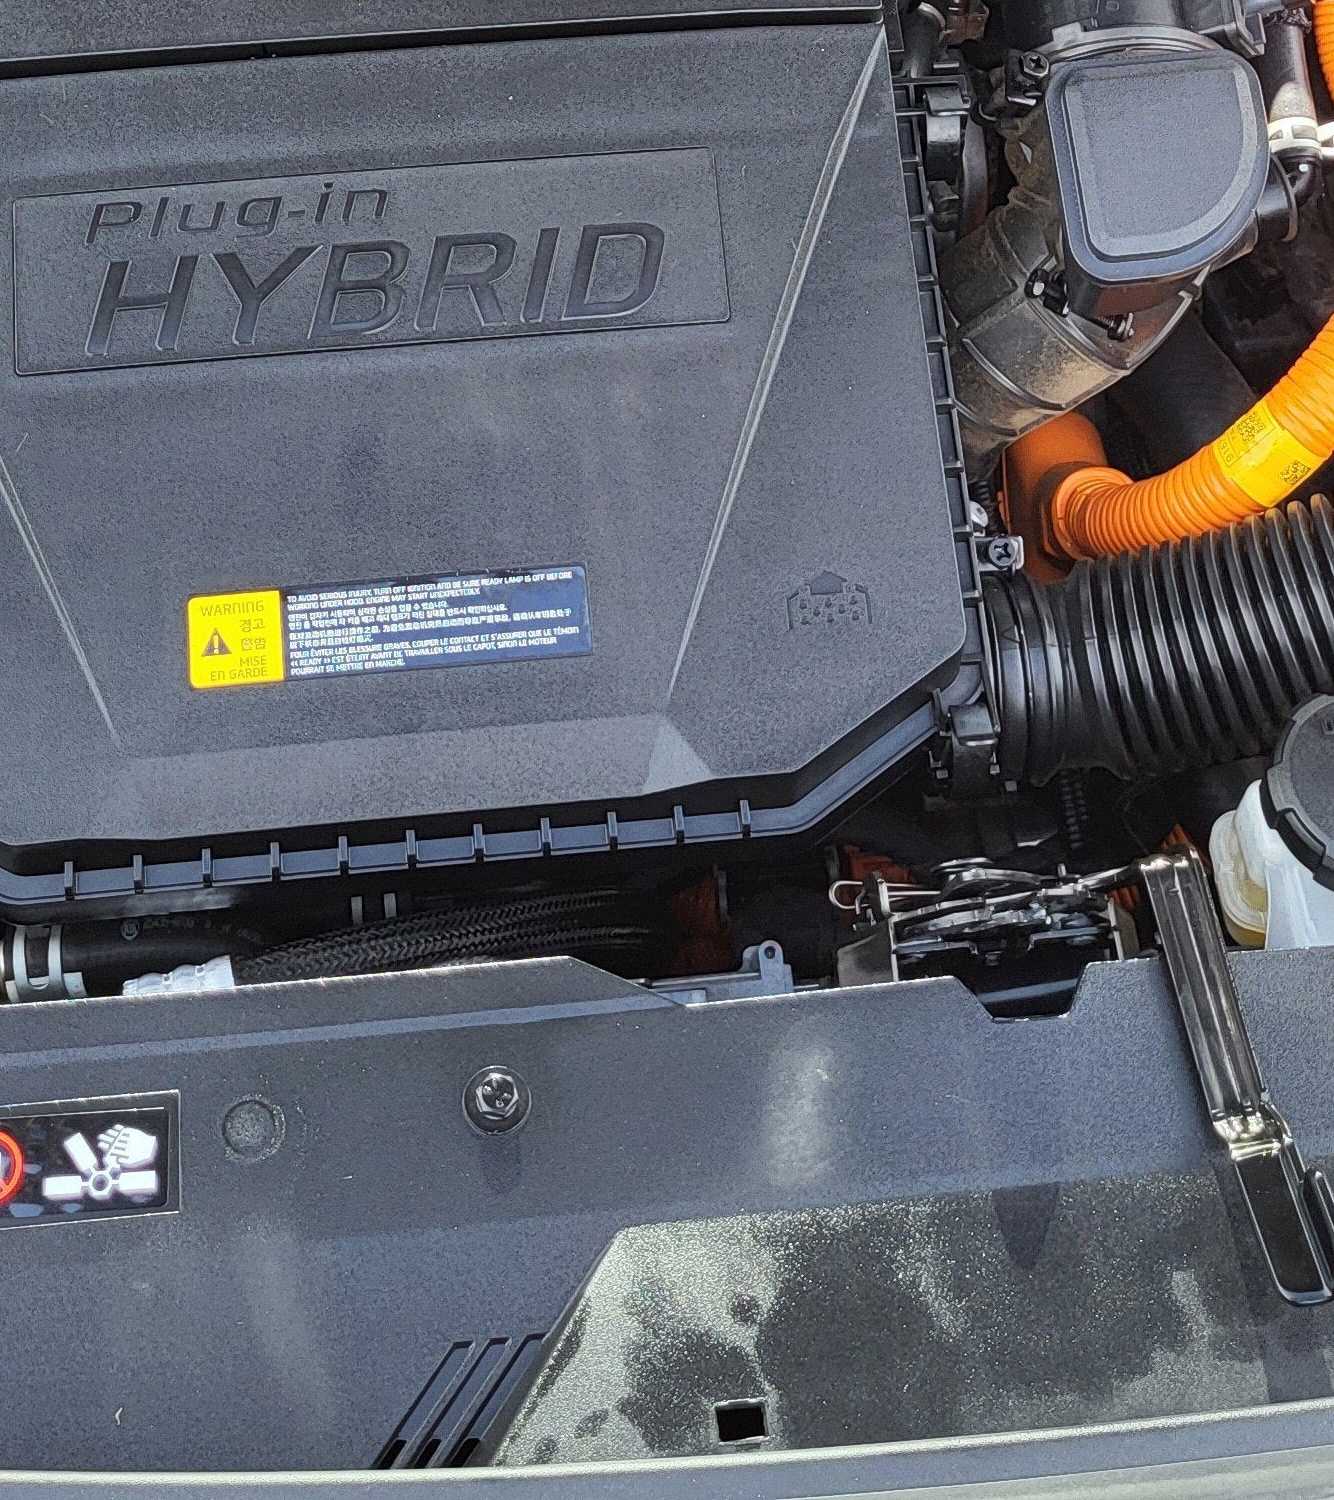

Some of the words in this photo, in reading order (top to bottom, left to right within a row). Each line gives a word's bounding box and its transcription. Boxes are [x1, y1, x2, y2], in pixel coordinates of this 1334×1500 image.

[85, 181, 390, 244] Plug-in
[84, 222, 666, 357] HYBRID
[287, 595, 296, 603] TO
[298, 593, 318, 601] AVOID
[319, 591, 347, 601] SERIOUS
[373, 587, 391, 595] TURN
[437, 582, 451, 590] AND
[463, 579, 480, 588] SURE
[481, 577, 503, 586] READY
[504, 576, 523, 584] LAMP
[546, 571, 573, 580] BEFORE
[200, 600, 265, 617] WARNING
[287, 602, 319, 611] WORKING
[320, 600, 343, 608] UNDER
[366, 595, 390, 604] ENGINE
[408, 592, 428, 600] START
[239, 618, 265, 633] 경고
[290, 650, 309, 658] POUR
[440, 637, 448, 646] LE
[481, 634, 489, 642] ET
[528, 629, 542, 637] QUE
[300, 657, 322, 665] READY
[332, 655, 344, 664] EST
[371, 652, 392, 660] AVANT
[444, 645, 462, 653] SOUS
[463, 644, 472, 652] LE
[529, 636, 557, 646] MOTEUR
[239, 655, 267, 668] MISE
[210, 670, 227, 681] EN
[229, 668, 268, 680] GARDE
